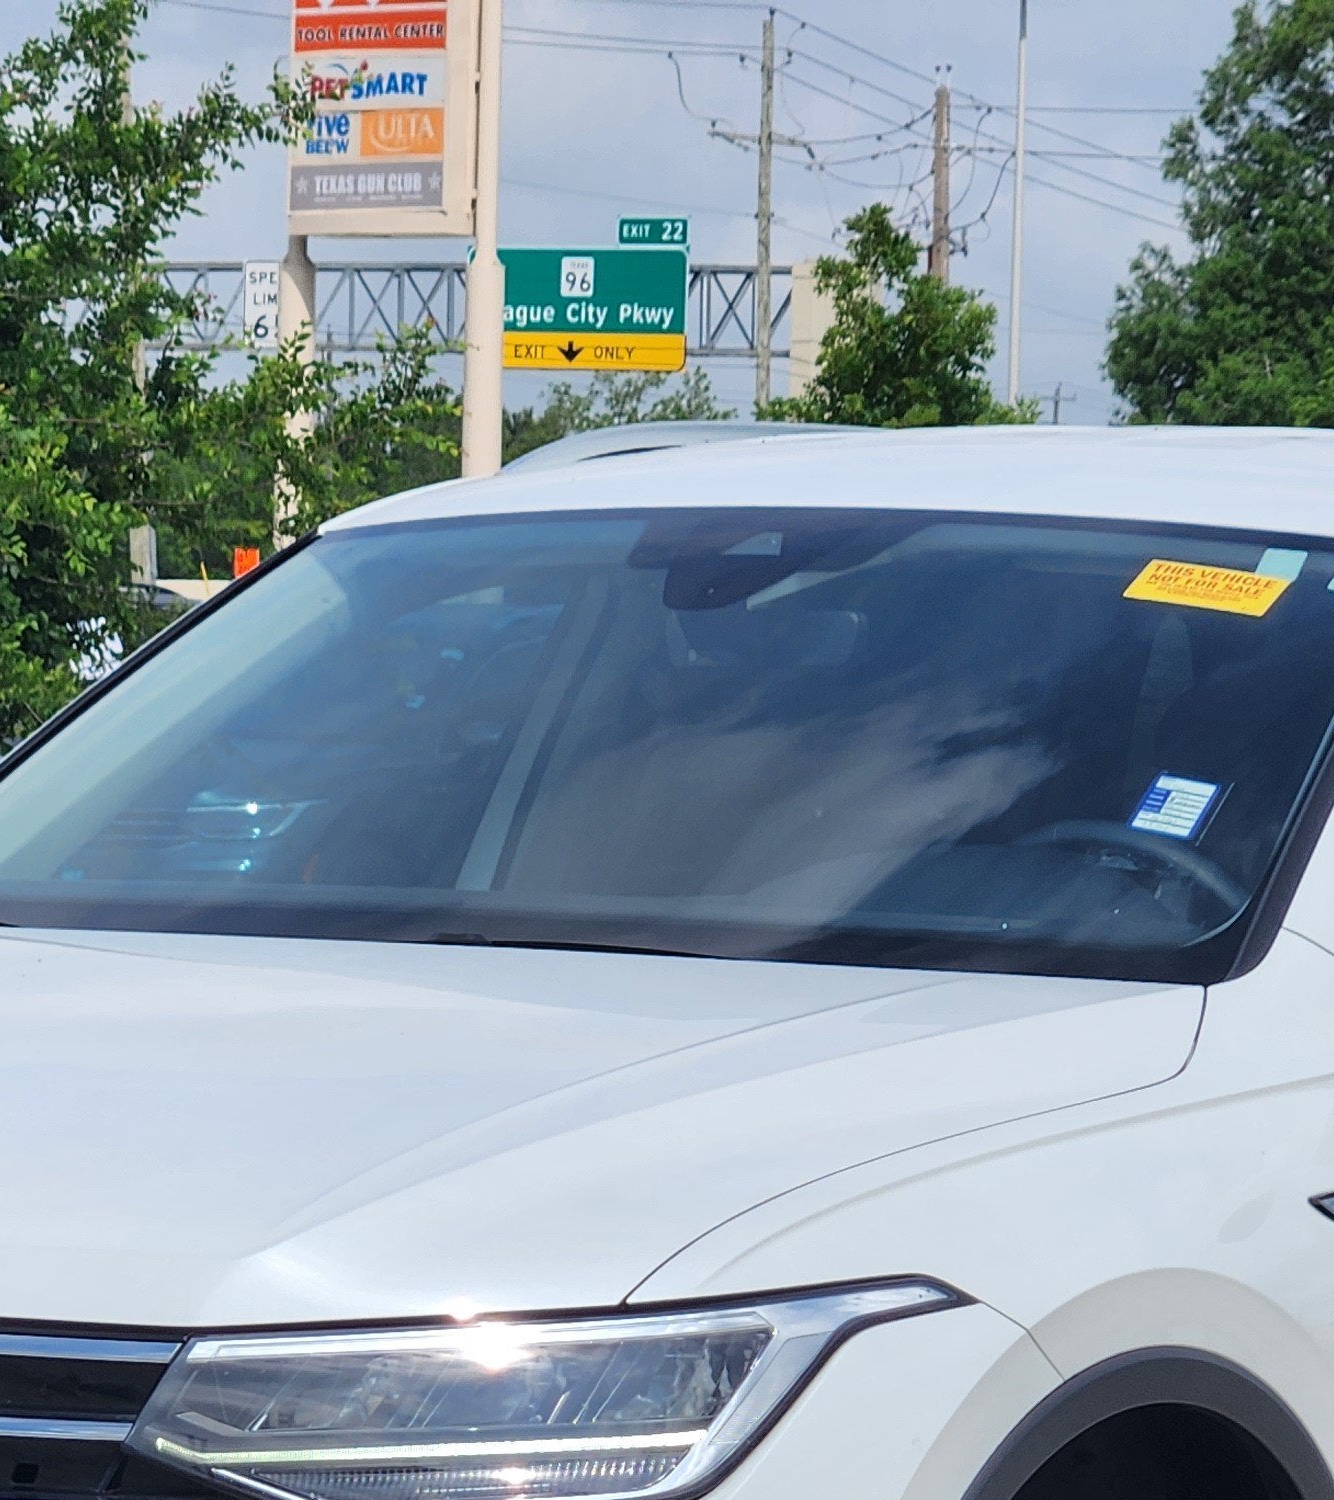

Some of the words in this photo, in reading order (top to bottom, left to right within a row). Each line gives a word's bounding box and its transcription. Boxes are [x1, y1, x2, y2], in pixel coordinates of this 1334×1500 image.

[297, 28, 333, 42] TOOL
[339, 25, 389, 41] RENTAL
[394, 23, 444, 39] CENTER
[378, 112, 436, 140] ULTA
[314, 174, 355, 194] TEXAS
[357, 173, 386, 193] GUN
[387, 172, 422, 192] CLUB
[622, 223, 650, 238] EXIT
[661, 221, 684, 241] 22
[249, 271, 277, 284] SPE
[565, 271, 591, 292] 96
[253, 293, 278, 305] LIM
[503, 304, 555, 327] ague
[566, 301, 608, 329] City
[619, 302, 675, 329] Pkwy
[253, 315, 278, 339] 6
[514, 344, 546, 359] EXIT
[593, 345, 636, 359] ONLY
[1148, 573, 1177, 585] NOT
[1184, 577, 1217, 590] FOR
[1224, 584, 1266, 596] SALE
[1153, 563, 1194, 577] THIS
[1200, 569, 1278, 589] VEHICLE
